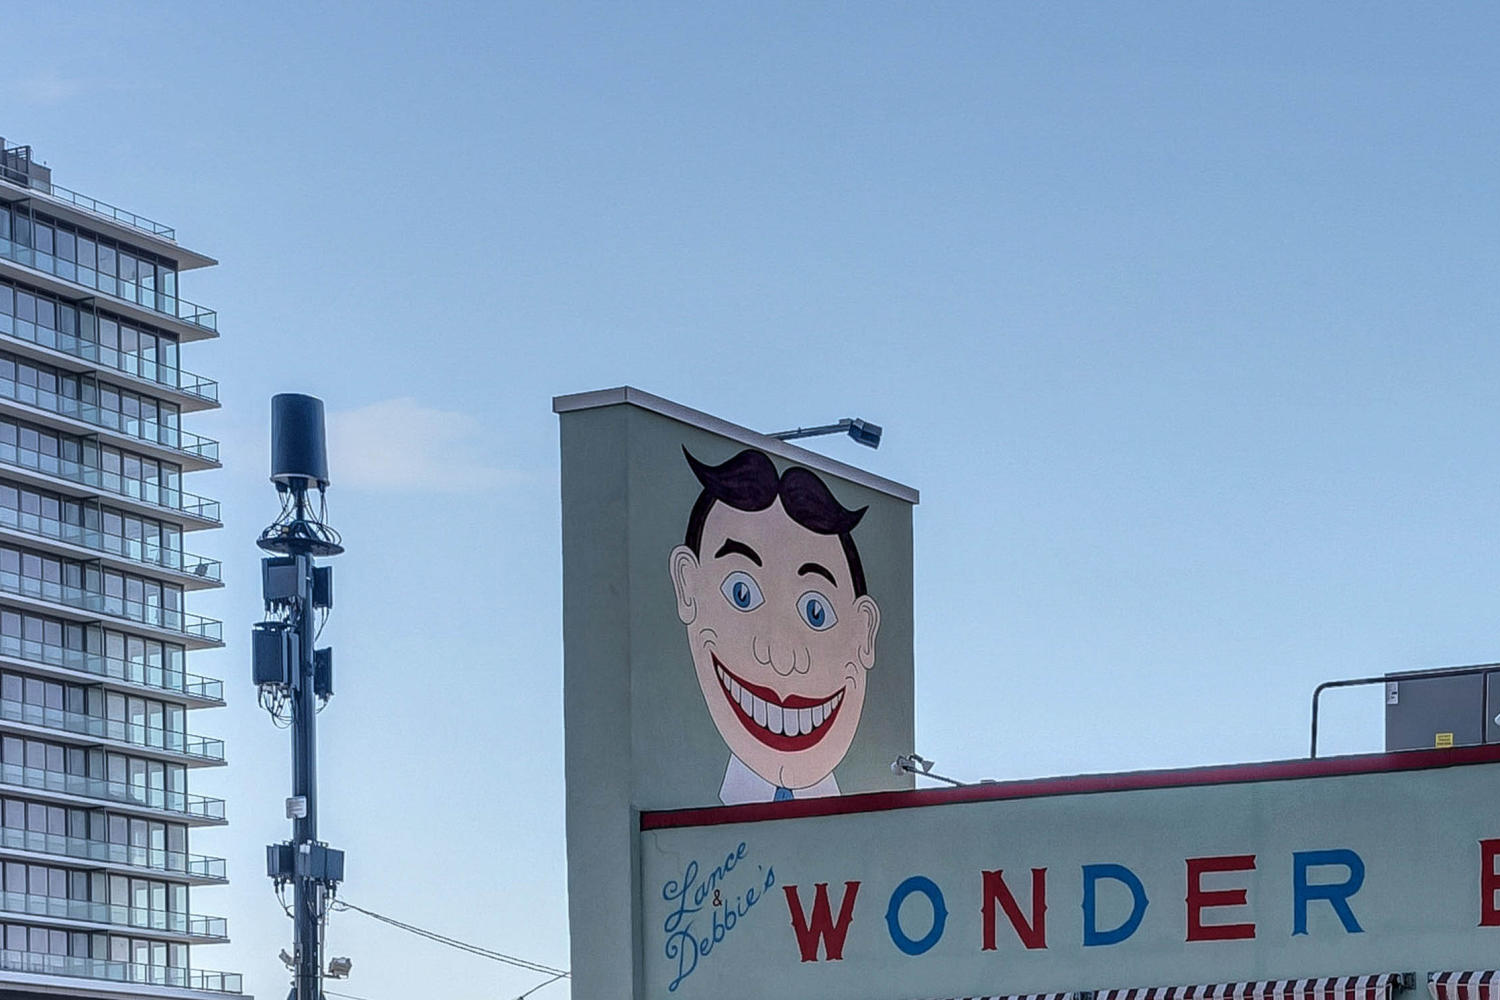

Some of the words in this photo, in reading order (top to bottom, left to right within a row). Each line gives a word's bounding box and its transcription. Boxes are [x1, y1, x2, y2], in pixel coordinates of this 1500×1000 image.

[663, 841, 748, 933] Lance
[665, 864, 776, 993] Debbie's
[712, 889, 723, 907] &
[782, 848, 1366, 963] WONDER
